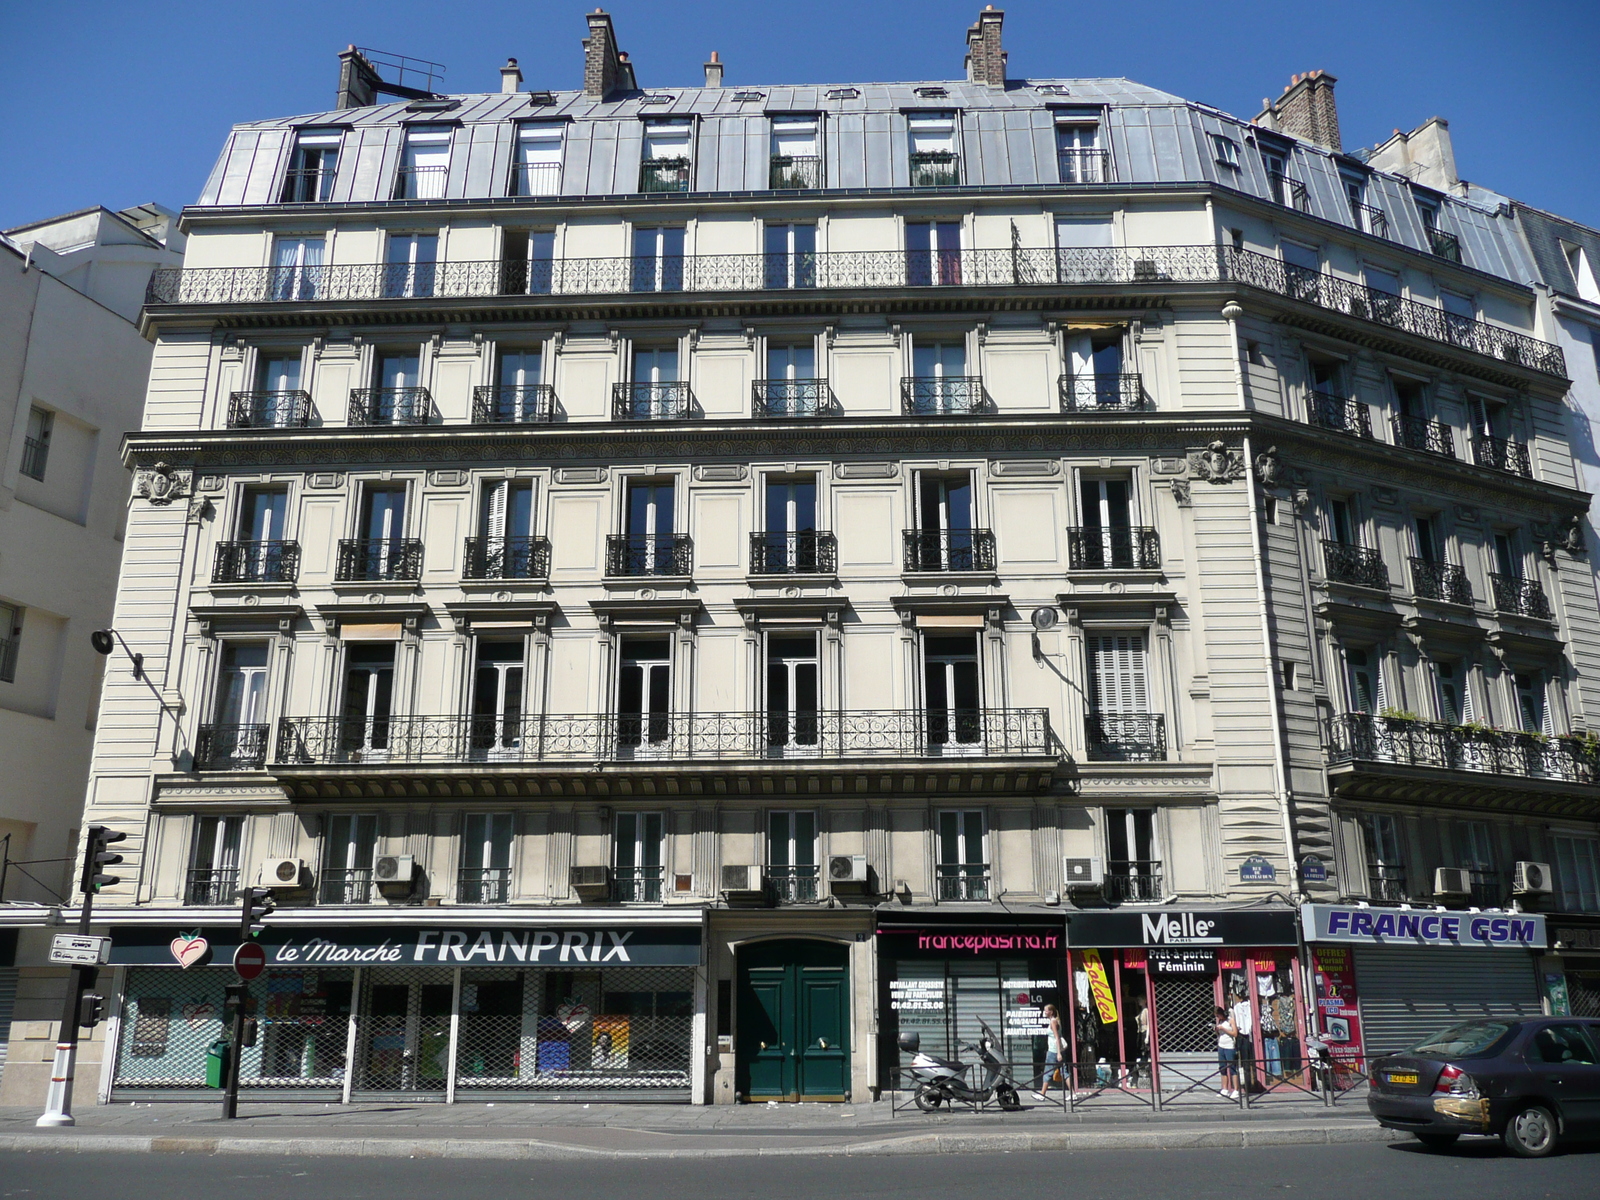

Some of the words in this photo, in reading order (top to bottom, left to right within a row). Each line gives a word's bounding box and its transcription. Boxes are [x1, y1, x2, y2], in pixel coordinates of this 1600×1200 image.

[1327, 911, 1460, 941] FRANCE
[1470, 918, 1536, 943] GSM
[303, 937, 402, 962] Marché
[413, 931, 634, 962] FRANPRIX
[918, 929, 1060, 954] franceplasma.fr
[1148, 949, 1214, 961] Prêt-à-porter
[1316, 949, 1347, 957] OFFRES
[1158, 961, 1205, 972] Féminin
[1083, 954, 1114, 1023] Soldes
[1031, 995, 1043, 1003] LG
[1318, 999, 1345, 1007] PLASMA
